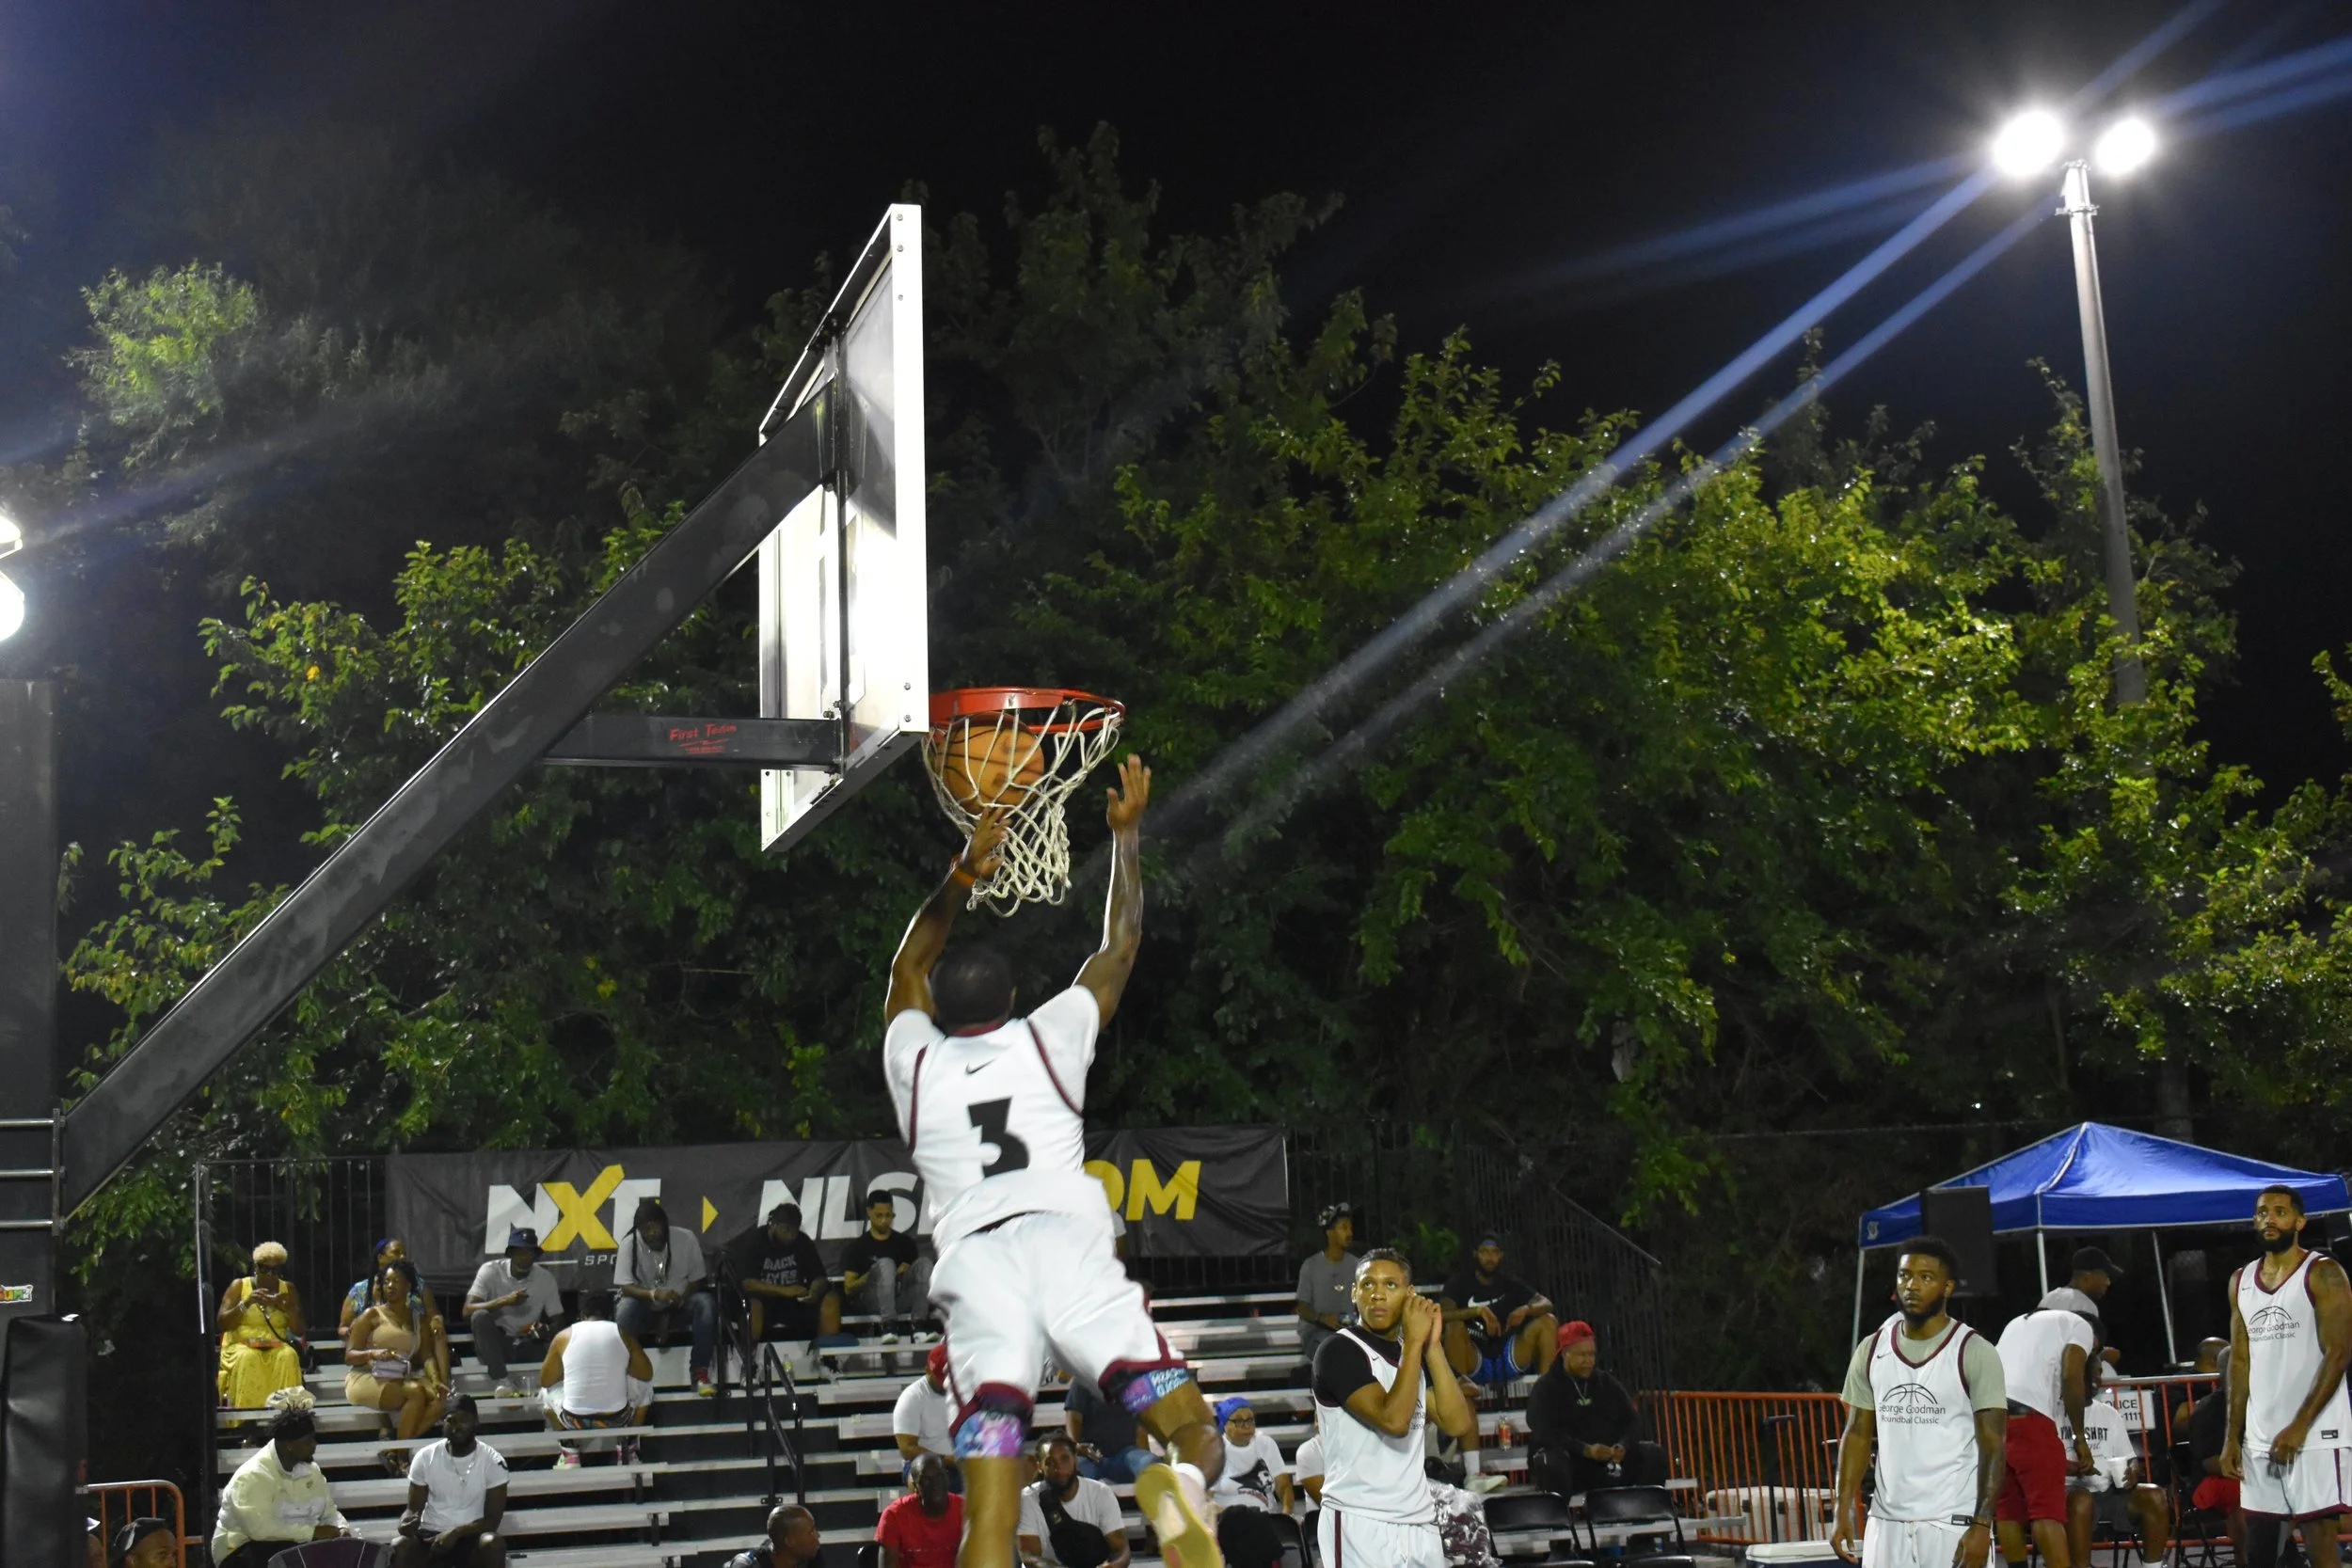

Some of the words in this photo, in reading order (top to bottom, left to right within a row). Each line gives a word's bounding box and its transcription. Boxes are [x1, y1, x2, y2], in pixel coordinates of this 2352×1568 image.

[967, 1095, 1031, 1179] 3
[485, 1164, 661, 1254] NXT
[1905, 1403, 1946, 1415] Goodman
[1914, 1416, 1939, 1424] Classic
